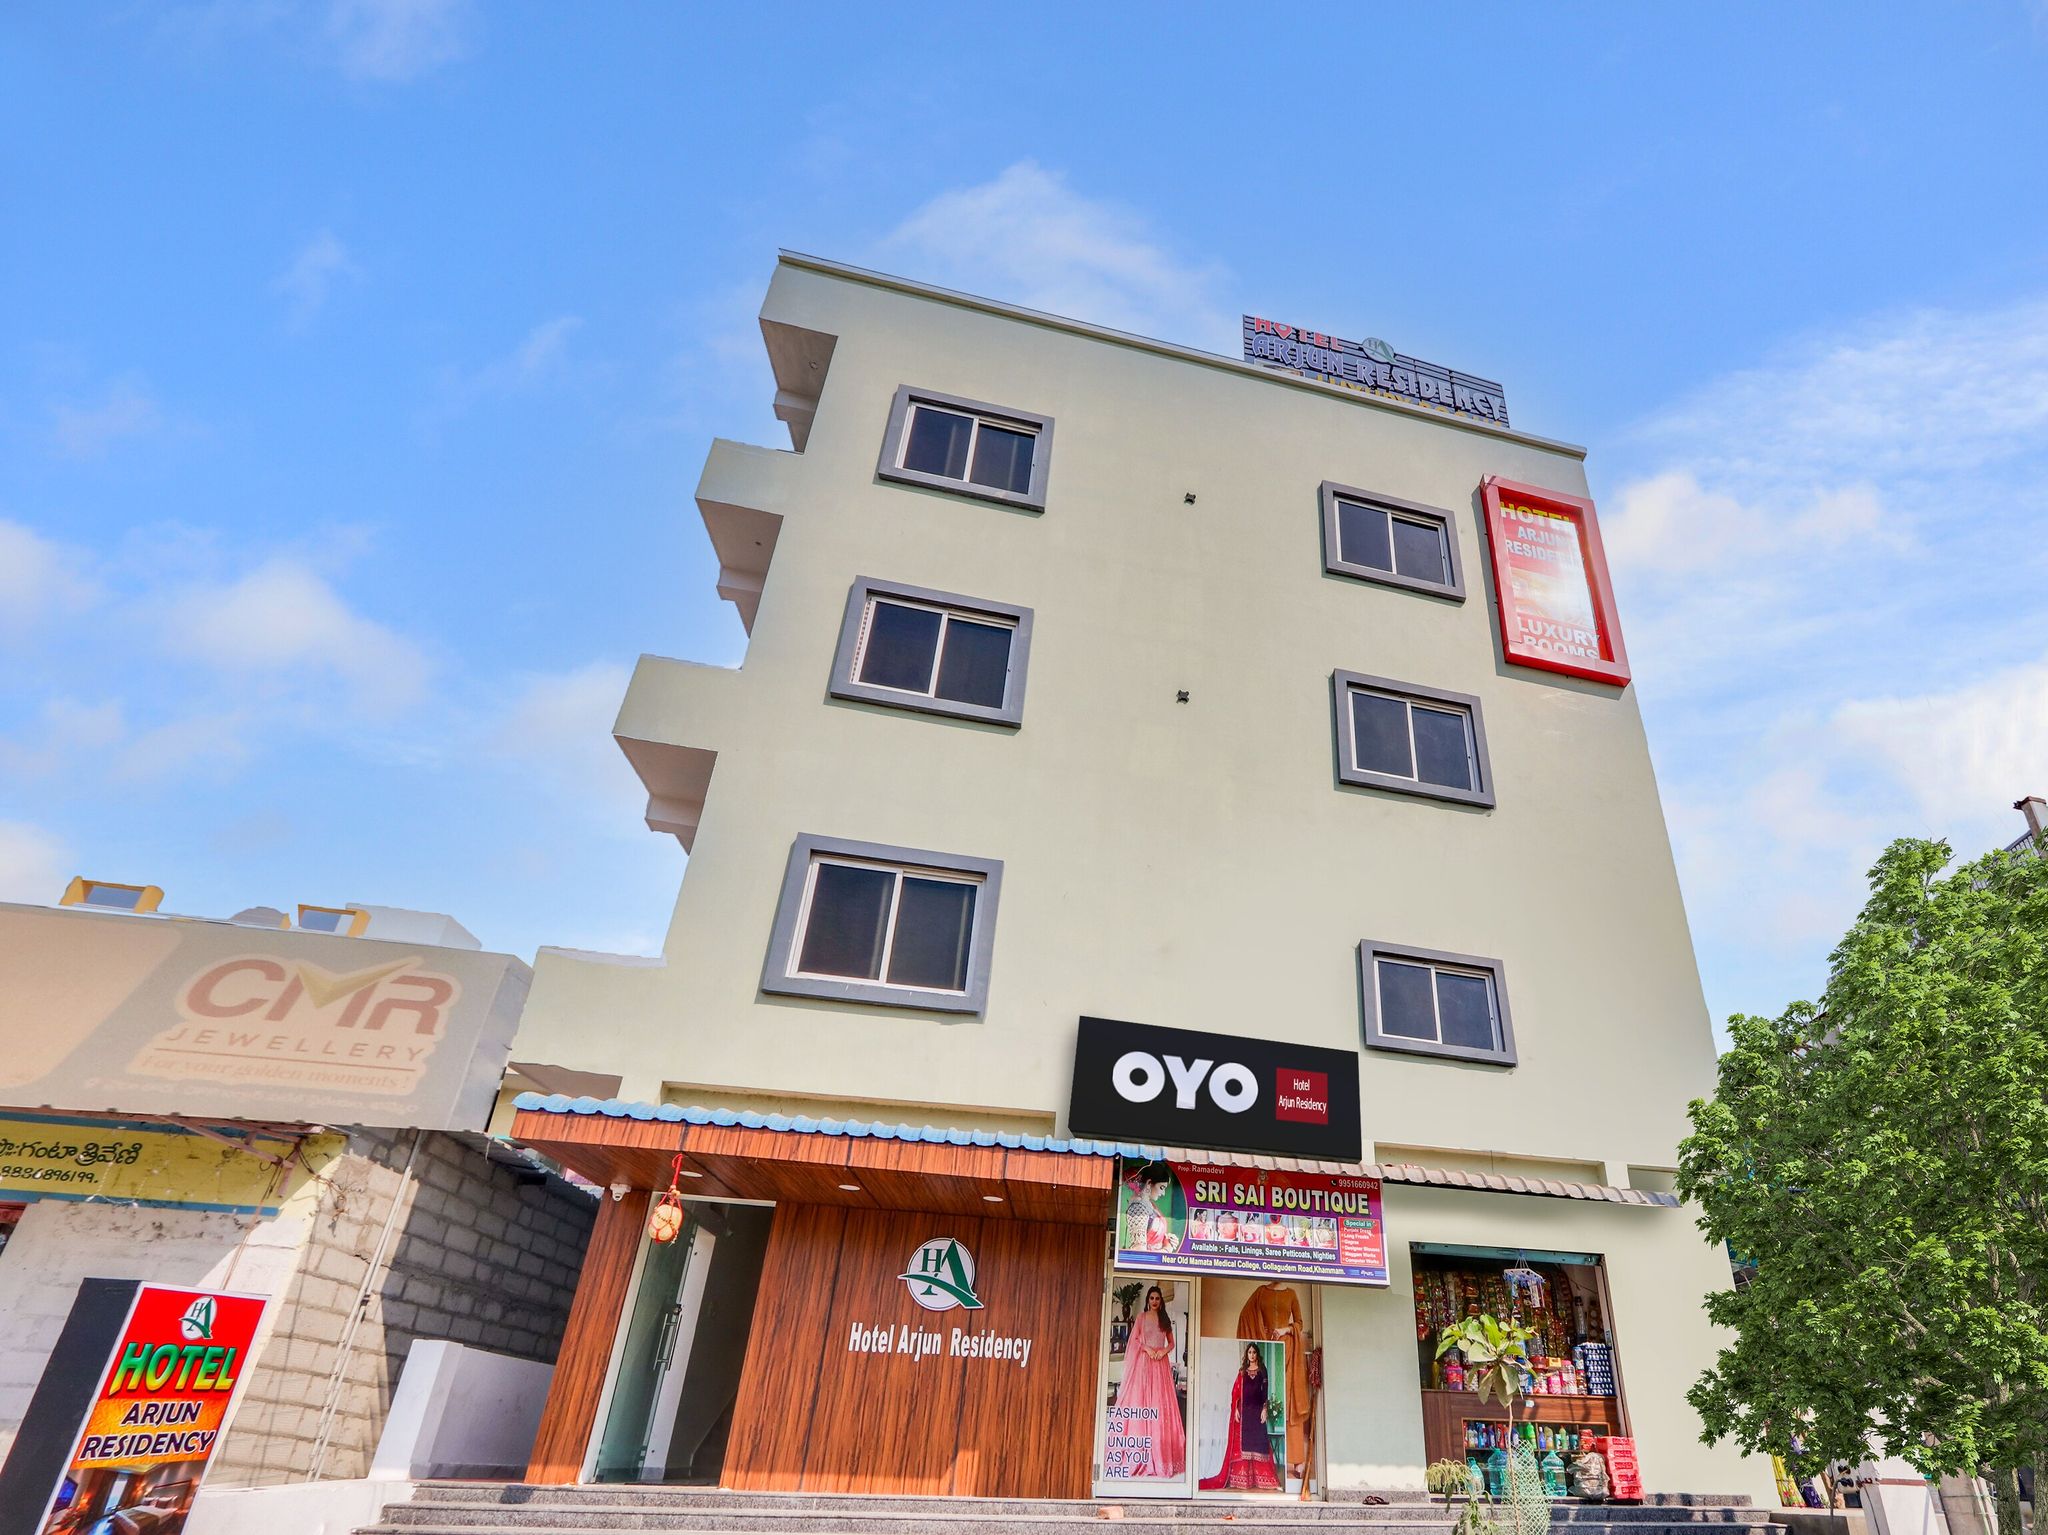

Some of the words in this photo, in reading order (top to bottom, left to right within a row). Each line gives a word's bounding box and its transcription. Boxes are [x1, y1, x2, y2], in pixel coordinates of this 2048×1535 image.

[1254, 317, 1344, 351] HOTEL
[1252, 334, 1344, 376] ARJUN
[1356, 359, 1502, 421] RESIDENCY
[1517, 616, 1600, 648] LUXURY
[187, 958, 454, 1035] CMR
[167, 1028, 425, 1062] JEWELLERY
[142, 1055, 175, 1071] For
[179, 1061, 230, 1078] your
[231, 1062, 301, 1085] golden
[1112, 1051, 1259, 1113] OYO
[1293, 1078, 1310, 1091] Hotel
[1279, 1095, 1295, 1110] Arjun
[1296, 1097, 1327, 1114] Residency
[1191, 1165, 1225, 1175] Ramadevi
[1195, 1180, 1227, 1204] SRI
[1233, 1183, 1265, 1207] SAI
[1338, 1179, 1379, 1190] 9951660942
[1345, 1219, 1366, 1228] Special
[1191, 1243, 1218, 1252] Available
[1224, 1245, 1240, 1254] Falls,
[1241, 1246, 1264, 1256] Linings,
[1265, 1247, 1281, 1256] Saree
[1313, 1251, 1336, 1261] Nighties
[1162, 1255, 1177, 1263] Near
[1177, 1256, 1189, 1264] Old
[1189, 1257, 1212, 1266] Mamata
[1213, 1259, 1236, 1267] Medical
[1237, 1260, 1261, 1270] College,
[1262, 1262, 1297, 1273] Gollagudem
[848, 1322, 895, 1353] Hotel
[896, 1325, 942, 1362] Arjun
[950, 1327, 1032, 1368] Residency
[109, 1342, 238, 1396] HOTEL
[121, 1401, 204, 1427] ARJUN
[1109, 1407, 1158, 1419] FASHION
[1108, 1421, 1123, 1433] AS
[79, 1430, 216, 1460] RESIDENCY
[1107, 1436, 1152, 1449] UNIQUE
[1106, 1451, 1122, 1462] AS
[1125, 1452, 1150, 1463] YOU
[1105, 1466, 1129, 1478] ARE
